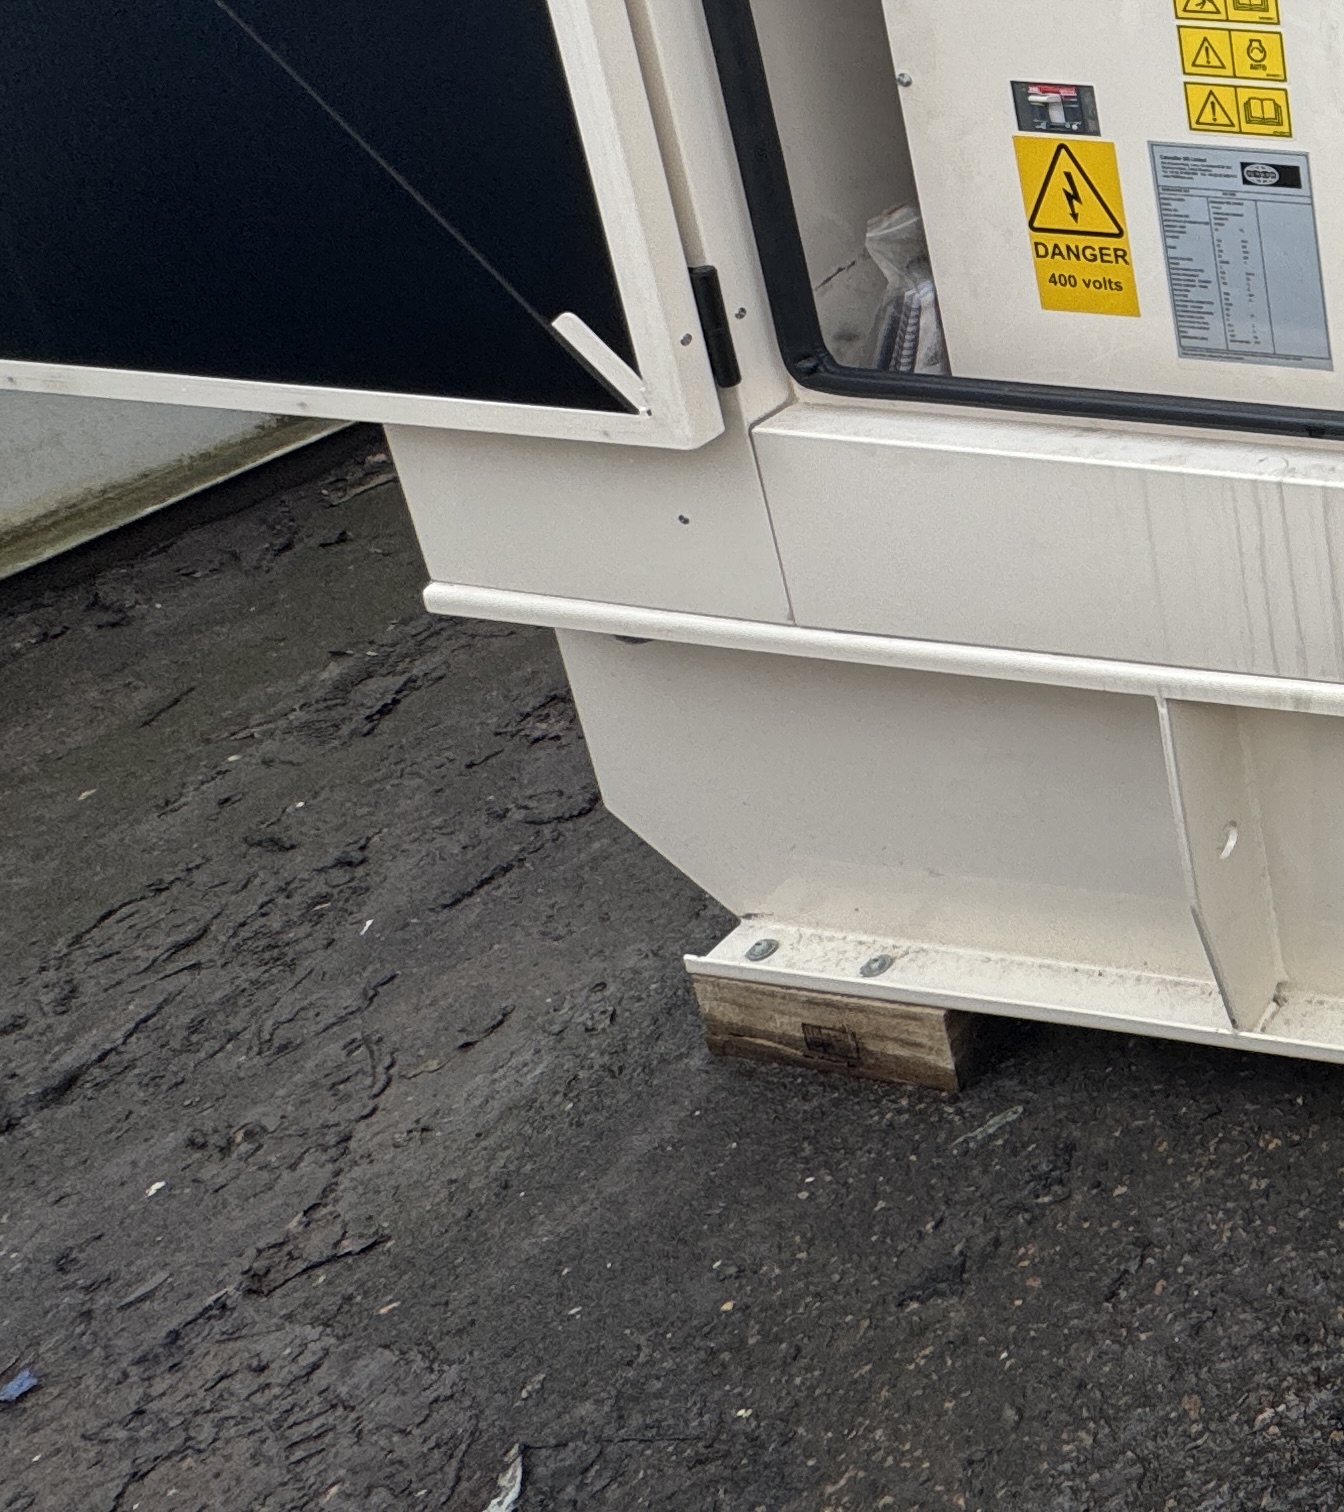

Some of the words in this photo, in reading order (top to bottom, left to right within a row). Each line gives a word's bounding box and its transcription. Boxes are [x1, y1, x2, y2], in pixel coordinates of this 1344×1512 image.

[1249, 63, 1268, 72] AUTO
[1033, 241, 1130, 266] DANGER
[1048, 272, 1078, 288] 400
[1082, 276, 1124, 292] volts
